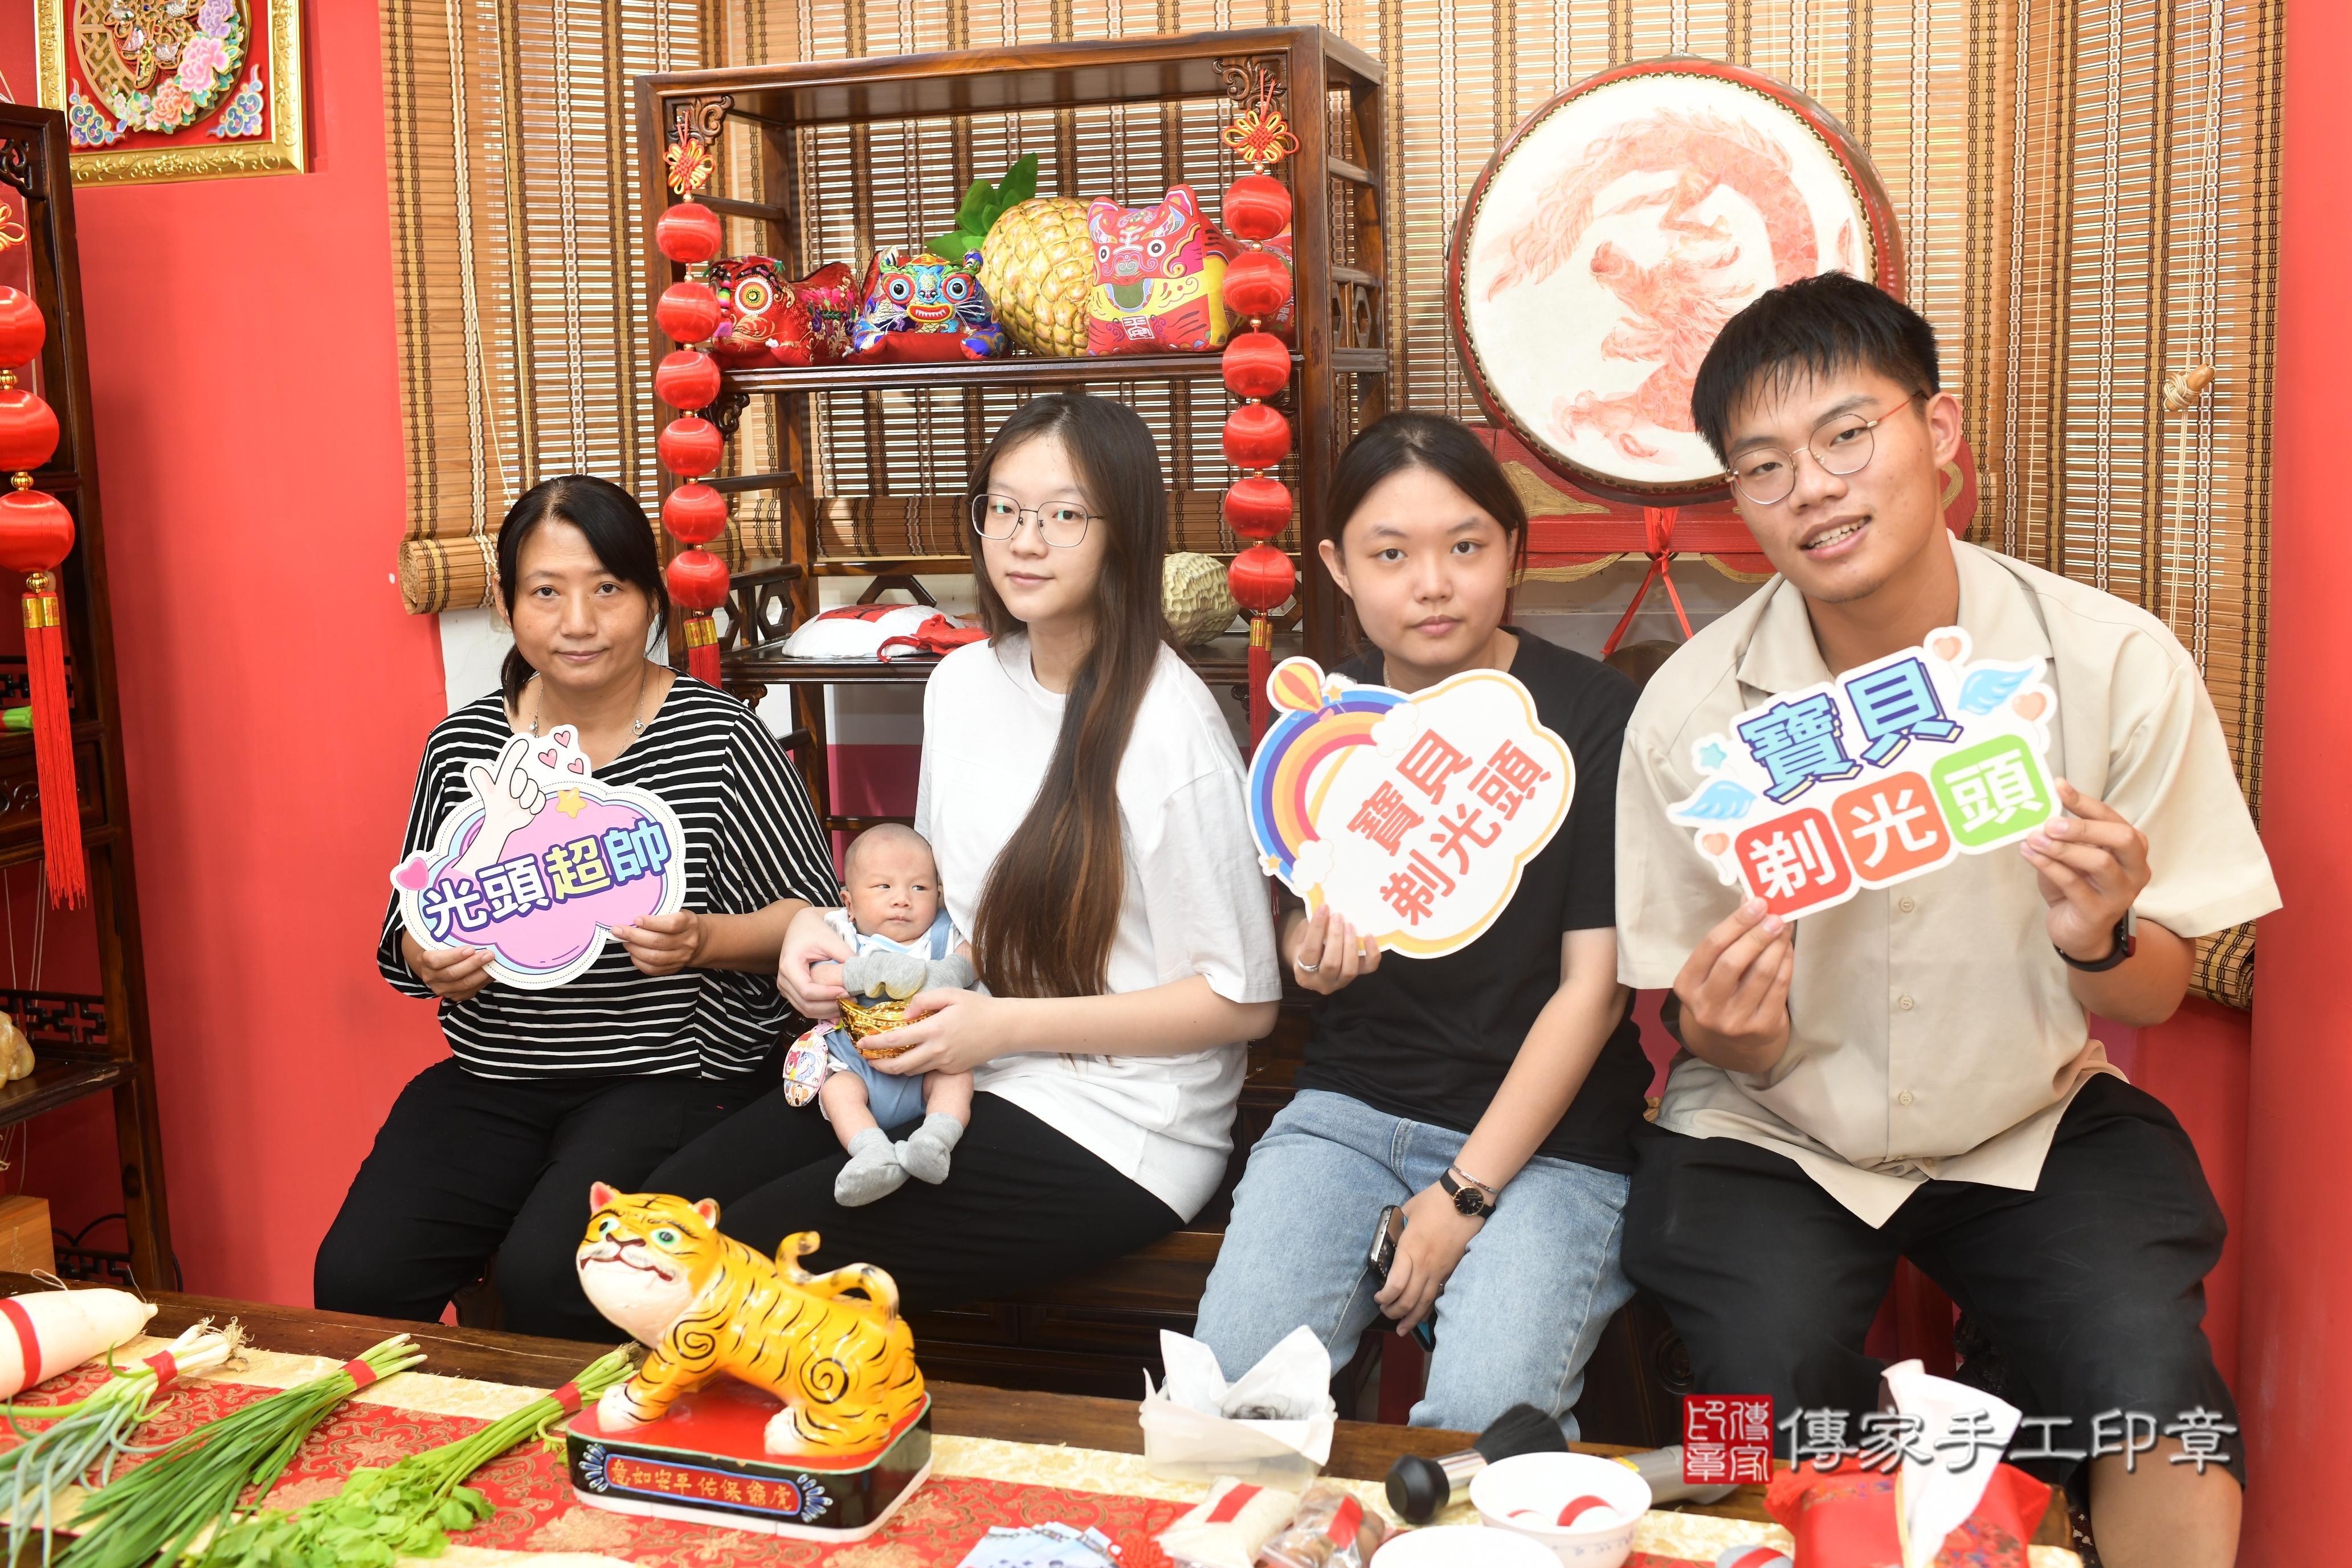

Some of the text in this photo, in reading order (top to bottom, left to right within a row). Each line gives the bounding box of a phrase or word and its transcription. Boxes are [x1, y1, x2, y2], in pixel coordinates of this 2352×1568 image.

[1346, 728, 1473, 856] 寶貝
[1737, 656, 1963, 805] 寶貝
[423, 816, 671, 941] 光頭超帥
[1380, 740, 1551, 925] 剃光頭
[1749, 748, 2043, 899] 剃光頭
